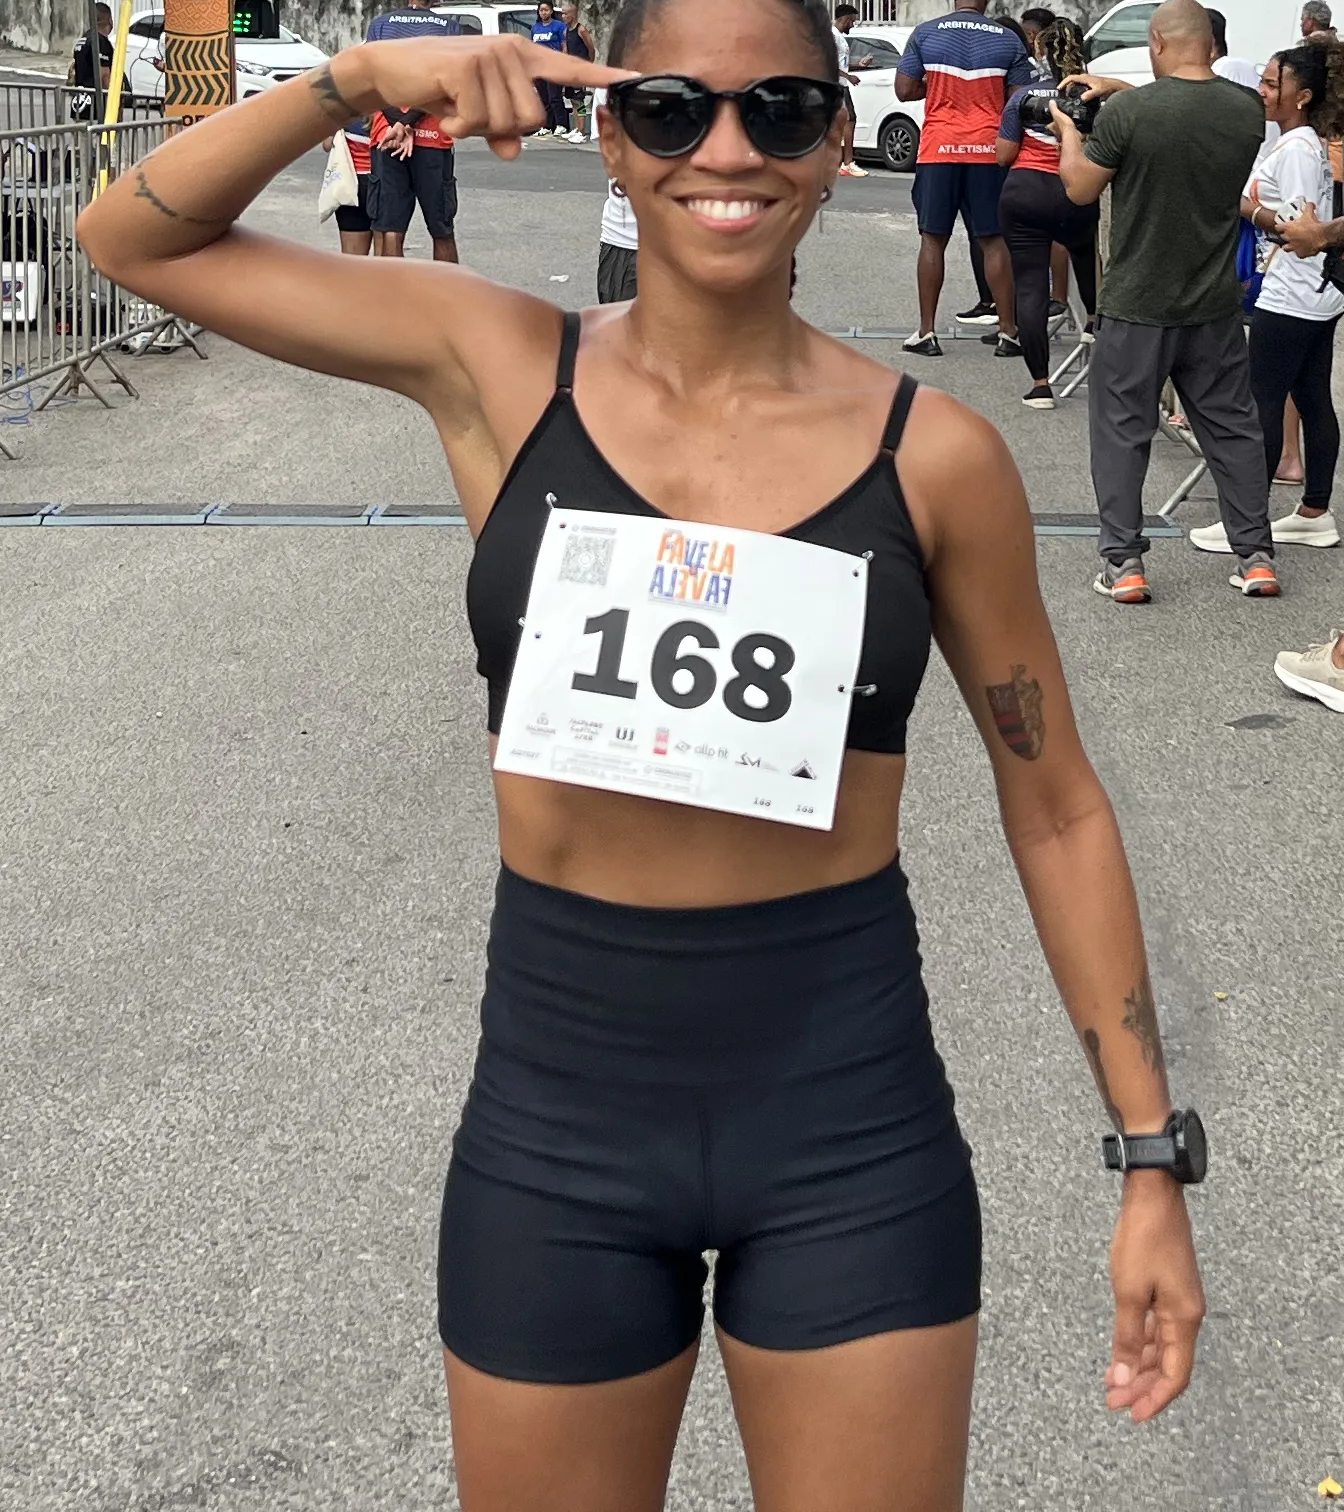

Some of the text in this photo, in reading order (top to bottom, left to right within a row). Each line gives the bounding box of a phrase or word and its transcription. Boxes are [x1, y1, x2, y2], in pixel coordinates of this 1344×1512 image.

[389, 15, 447, 27] ARBITRAGEM
[937, 21, 1004, 35] ARBITRAGEM
[657, 530, 736, 575] FAVELA
[570, 608, 796, 723] 168
